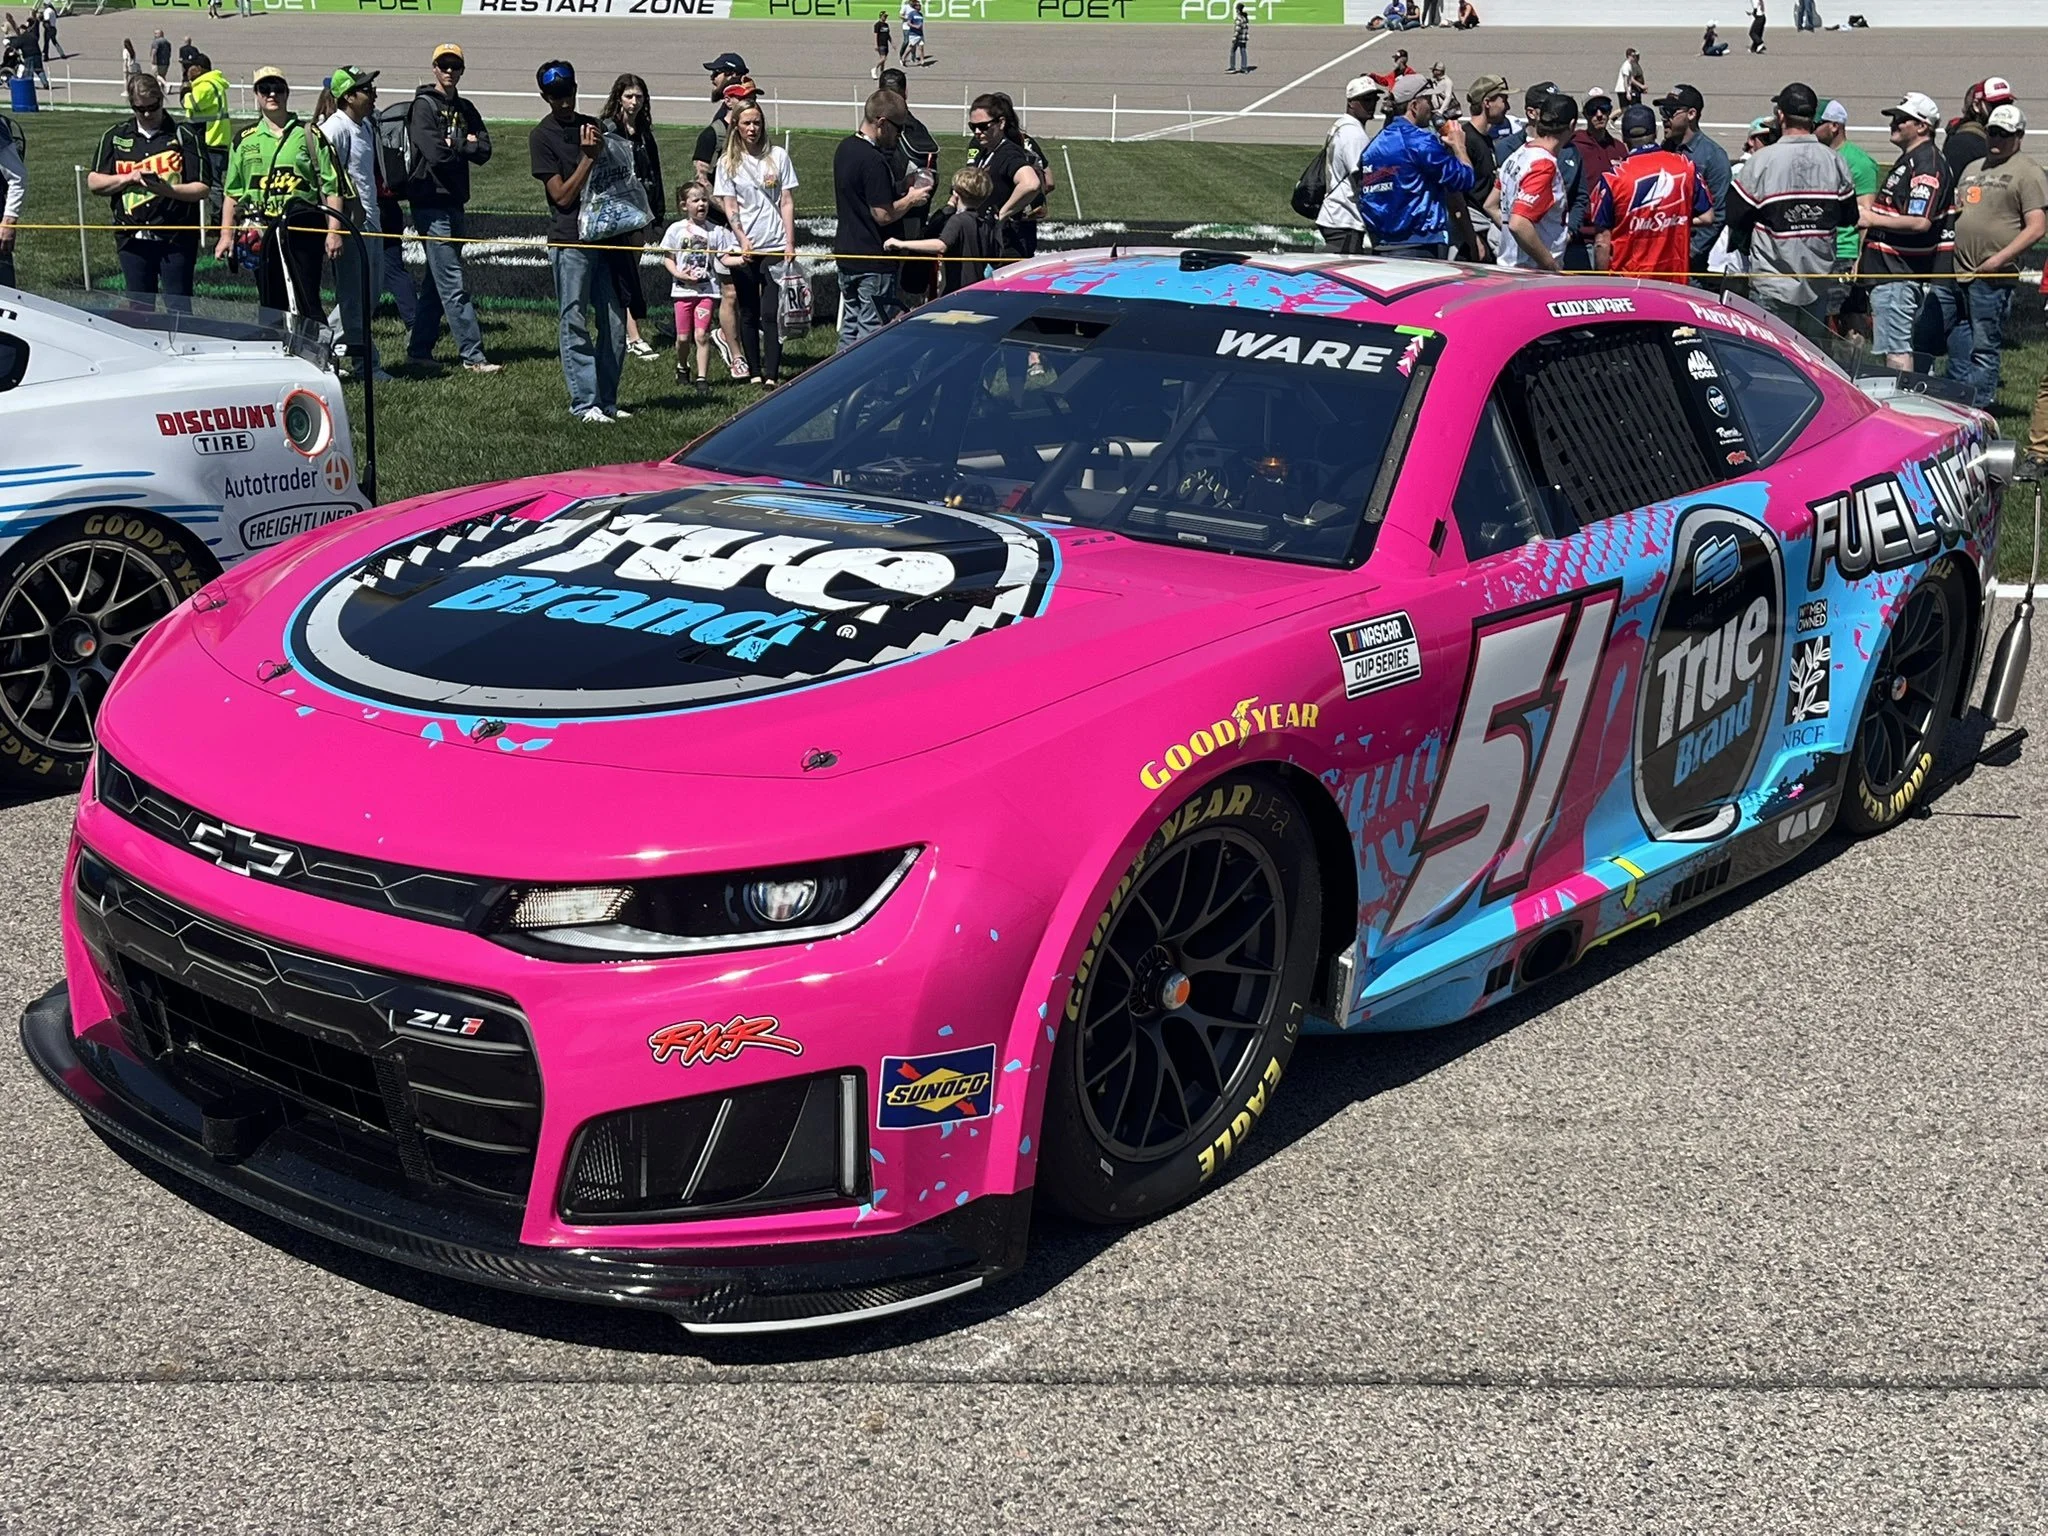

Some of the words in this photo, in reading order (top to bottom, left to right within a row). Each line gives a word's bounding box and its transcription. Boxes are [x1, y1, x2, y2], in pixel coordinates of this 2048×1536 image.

[479, 0, 613, 12] RESTART
[629, 0, 715, 14] ZONE
[902, 0, 990, 18] OET
[1038, 0, 1133, 19] POET
[1180, 0, 1284, 20] POET
[1650, 211, 1688, 232] Spice
[1217, 329, 1394, 375] WARE
[155, 403, 278, 436] DISCOUNT
[197, 436, 249, 453] TIRE
[224, 468, 318, 499] Autotrader
[1809, 479, 1937, 585] FUEL
[458, 510, 956, 624] True
[428, 574, 826, 663] Brand
[1359, 619, 1403, 649] NASCAR
[1354, 659, 1375, 681] CUP
[1375, 648, 1409, 674] SERIES
[1656, 595, 1770, 750] True
[1138, 697, 1320, 791] GOODYEAR
[1672, 681, 1756, 789] Brand
[1781, 724, 1826, 750] NBCF
[1383, 590, 1619, 938] 51
[406, 1007, 485, 1036] ZL1
[884, 1072, 991, 1108] SUNOCO
[1198, 1057, 1283, 1183] EAGLE
